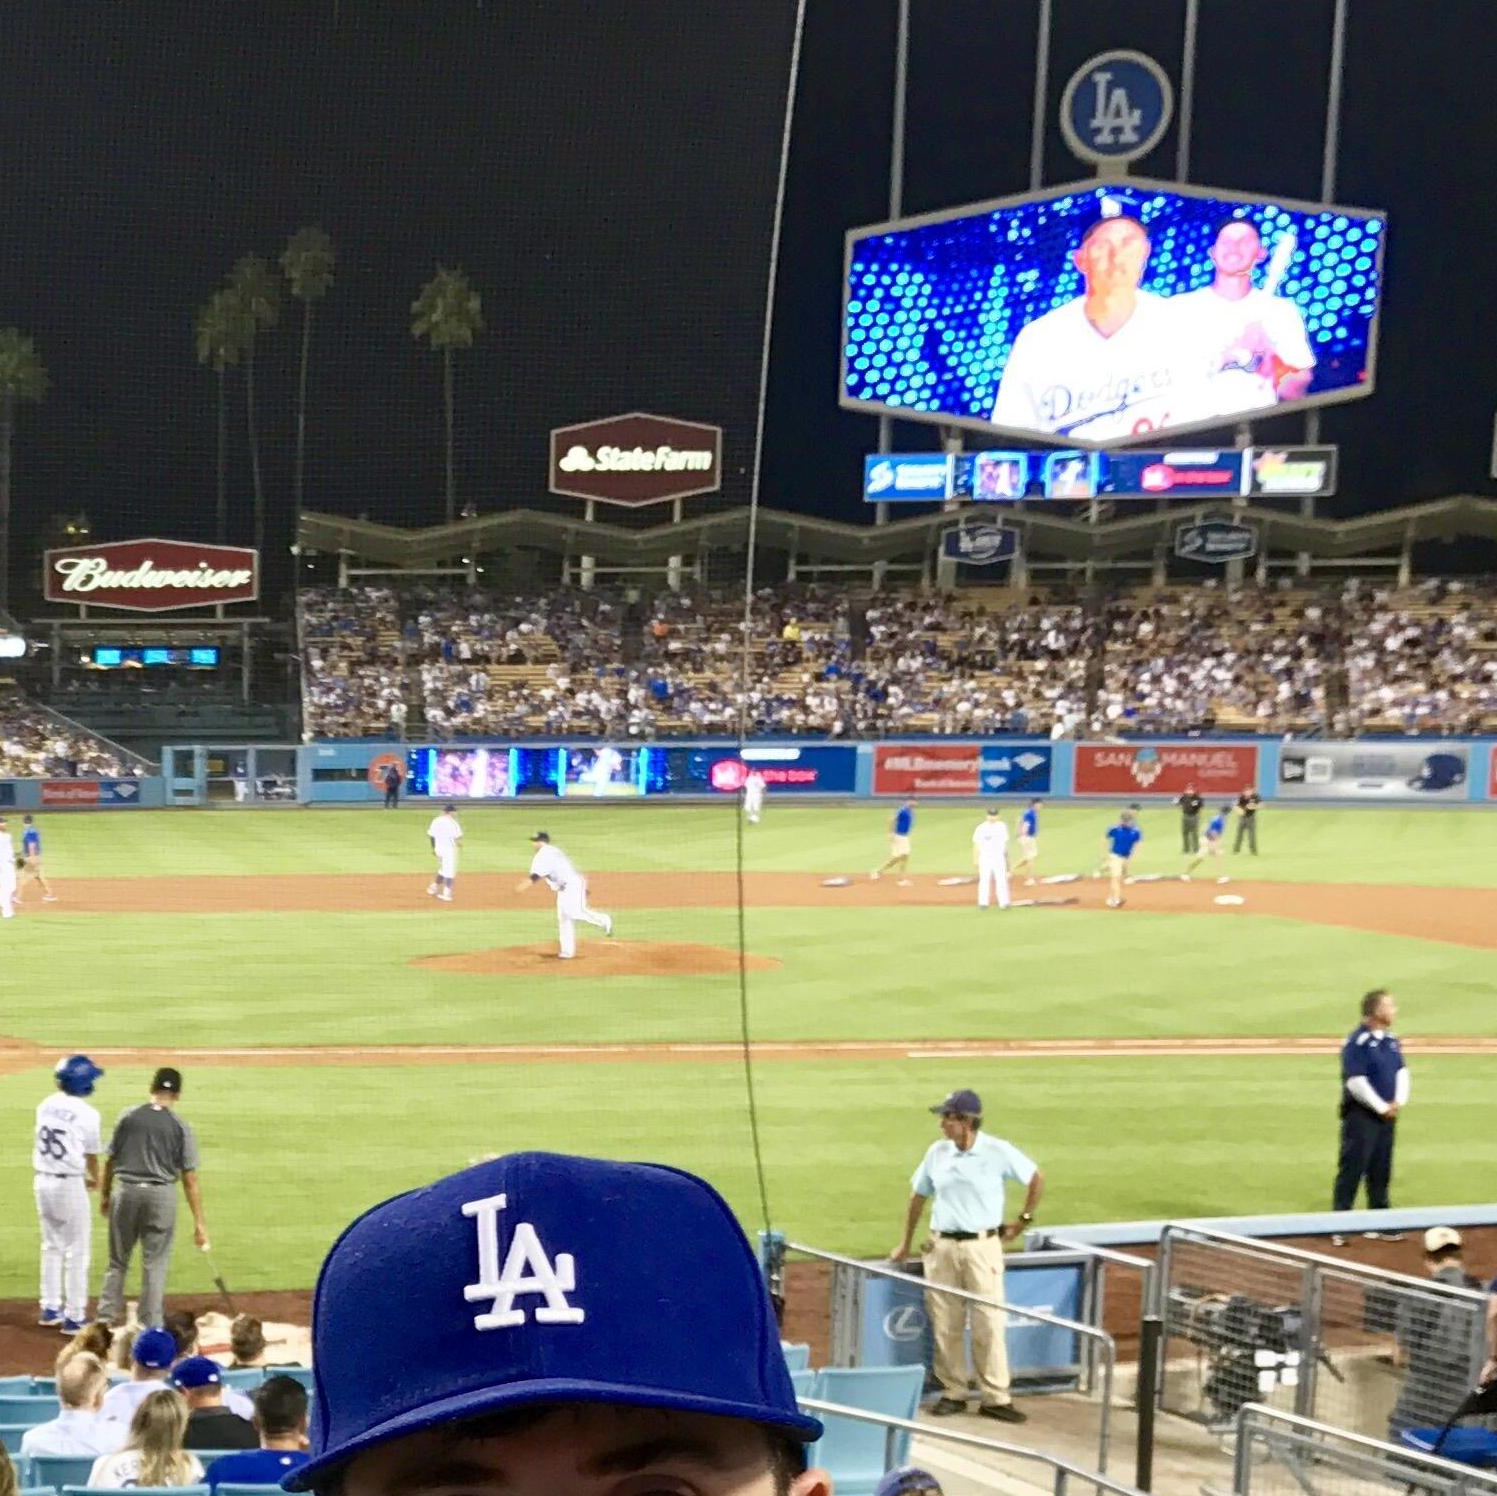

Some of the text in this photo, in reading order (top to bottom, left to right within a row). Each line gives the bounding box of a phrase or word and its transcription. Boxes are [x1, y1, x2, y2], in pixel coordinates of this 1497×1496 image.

[1089, 71, 1142, 145] LA
[54, 557, 252, 592] Budweiser
[1094, 752, 1238, 768] SAN MANUEL
[461, 1193, 585, 1332] LA
